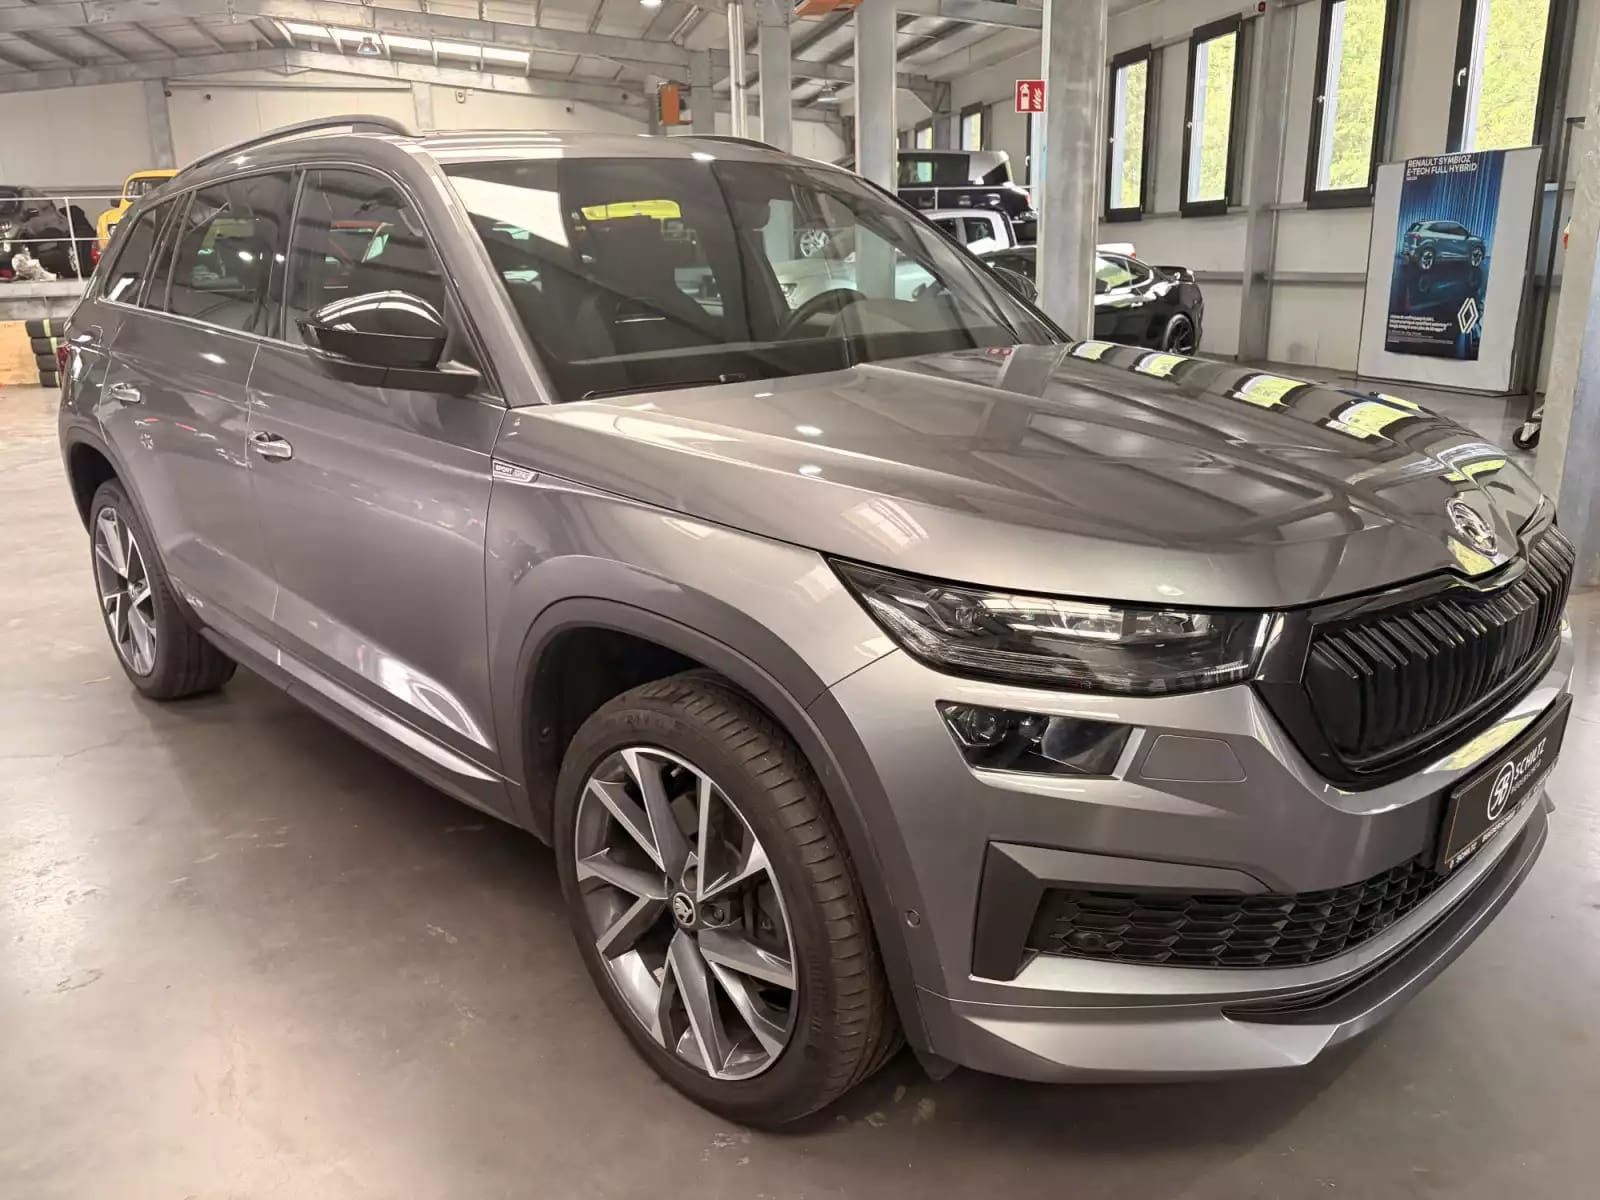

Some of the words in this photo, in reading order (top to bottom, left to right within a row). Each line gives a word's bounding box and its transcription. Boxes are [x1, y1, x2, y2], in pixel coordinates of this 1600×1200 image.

[1407, 157, 1438, 169] RENAULT
[1438, 154, 1472, 166] SYMBIOZ
[1406, 167, 1430, 177] E-TECH
[1431, 165, 1448, 174] FULL
[1449, 162, 1478, 173] HYBRID
[1514, 736, 1547, 780] SCHILTZ
